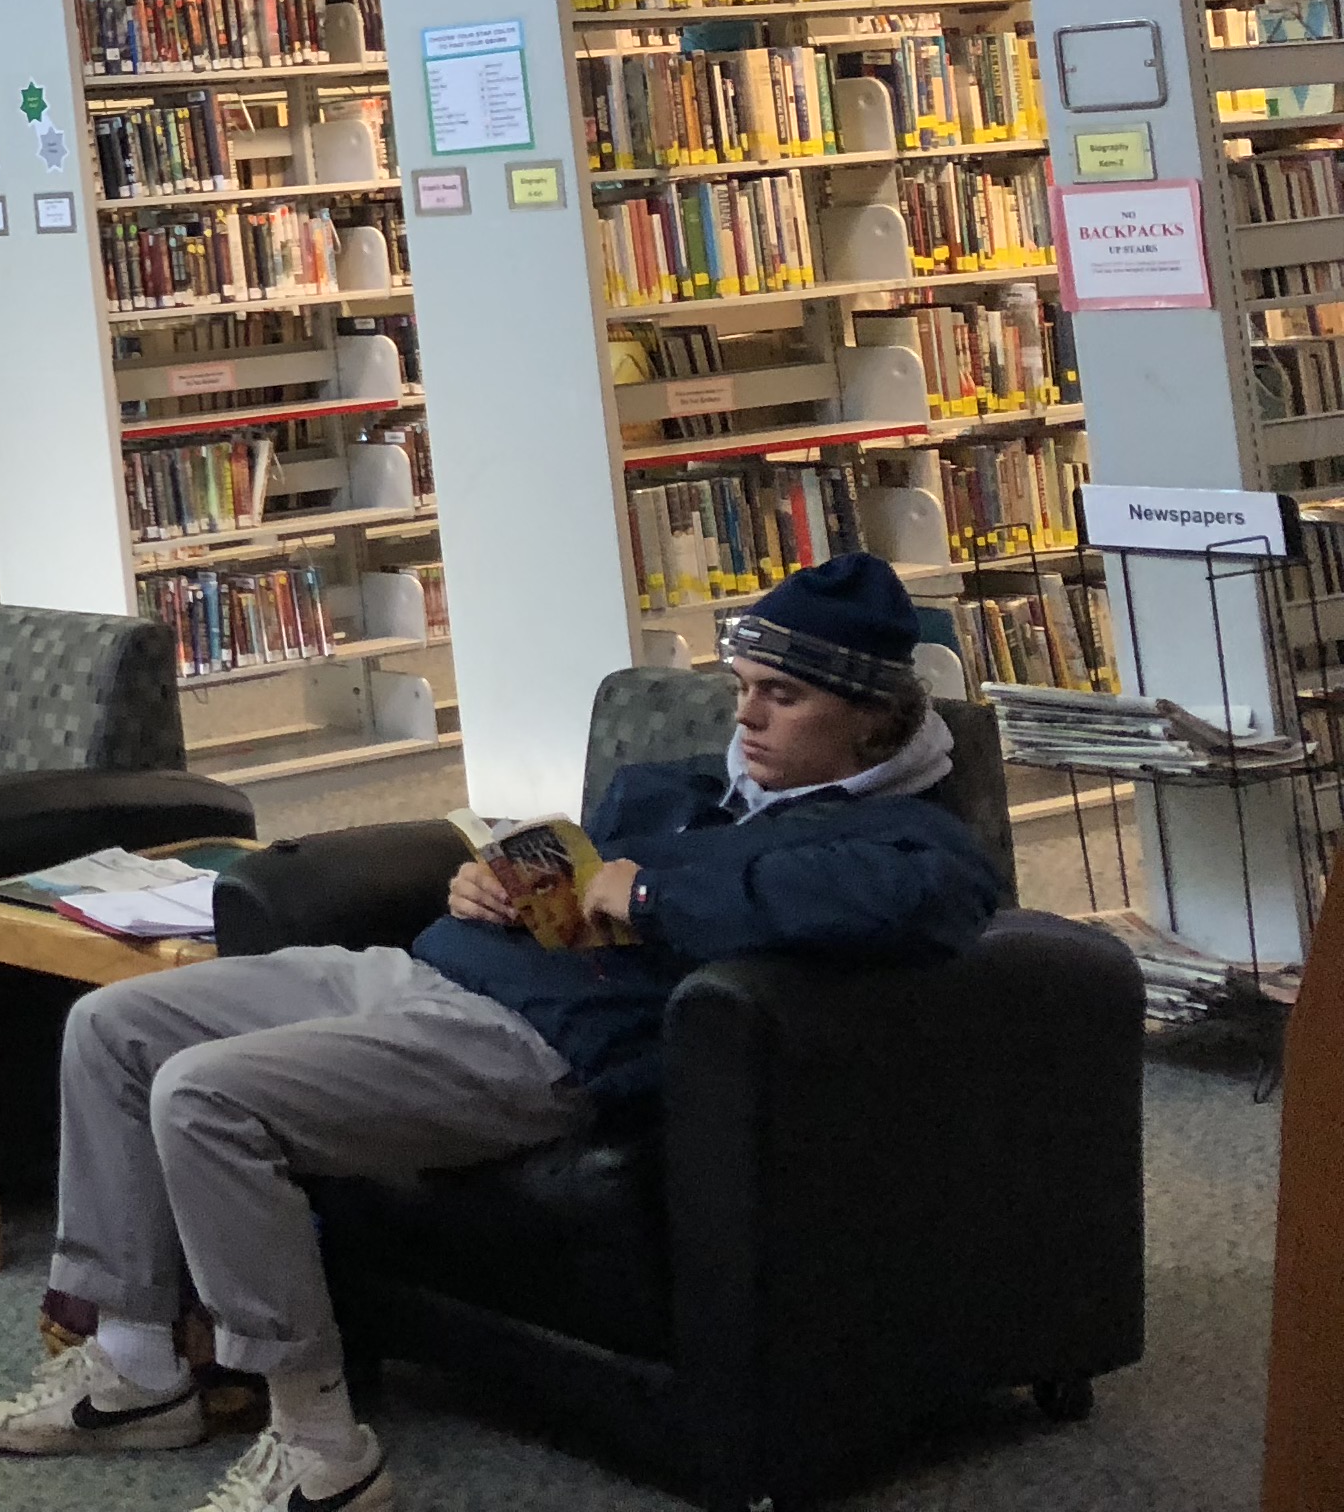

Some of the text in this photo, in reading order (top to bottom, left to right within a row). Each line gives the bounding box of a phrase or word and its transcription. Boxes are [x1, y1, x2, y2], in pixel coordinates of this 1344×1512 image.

[1090, 143, 1129, 154] Biography
[1121, 211, 1136, 219] NO
[1079, 223, 1185, 241] BACKPACKS
[1128, 504, 1246, 527] Newspapers
